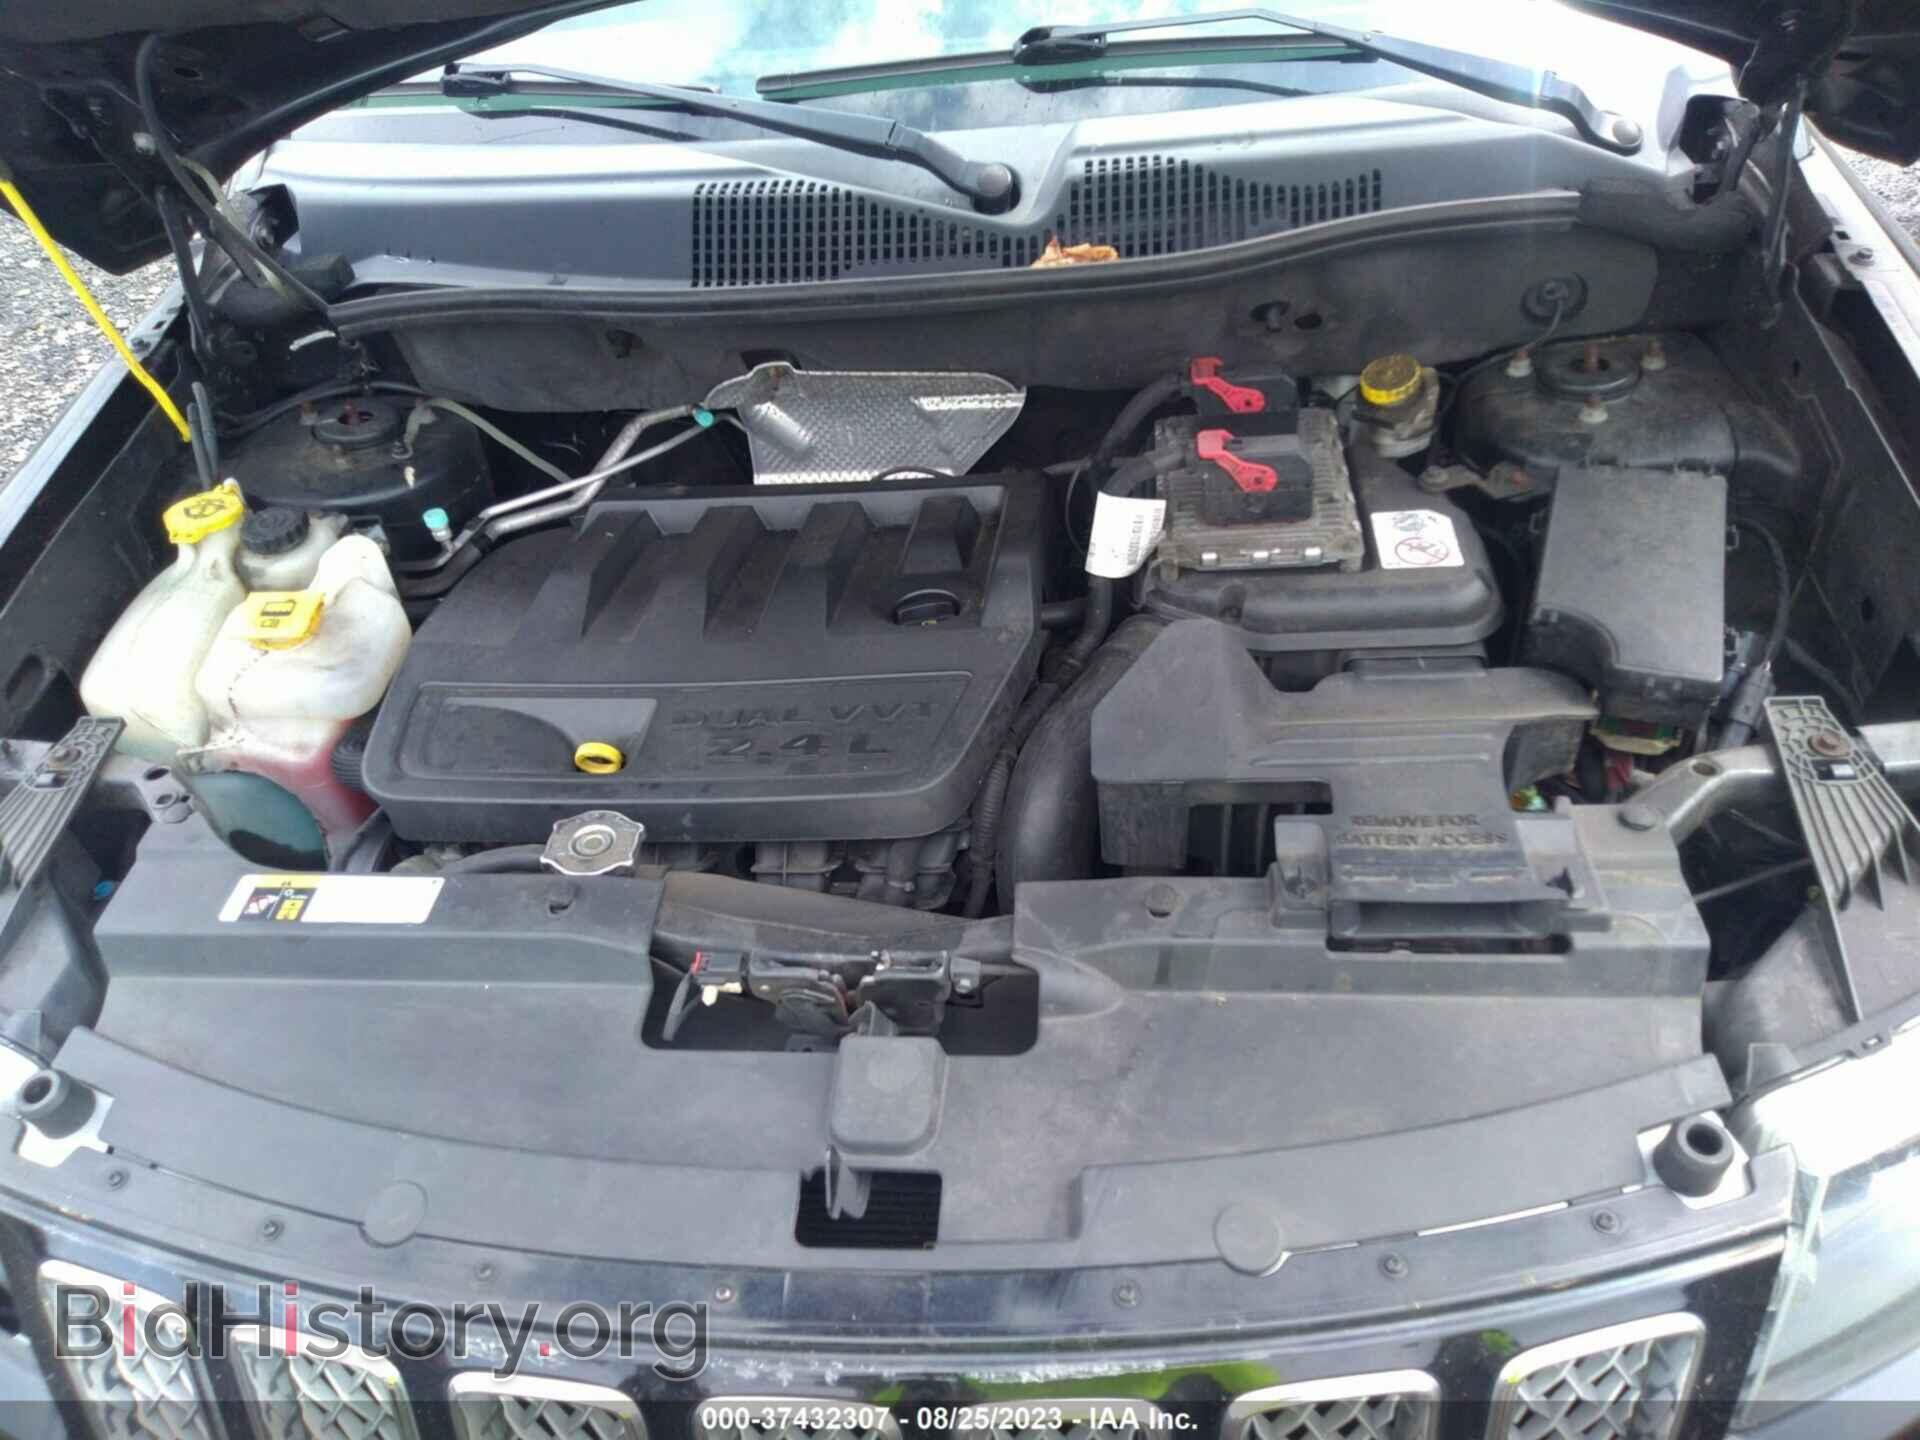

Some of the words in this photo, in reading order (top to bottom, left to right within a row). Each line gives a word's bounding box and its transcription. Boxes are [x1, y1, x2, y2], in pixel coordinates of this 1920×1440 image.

[671, 704, 812, 729] DUAL
[1351, 814, 1434, 828] REMOVE
[1438, 813, 1481, 827] FOR
[1336, 831, 1419, 847] BATTERY
[1430, 831, 1508, 847] ACCESS
